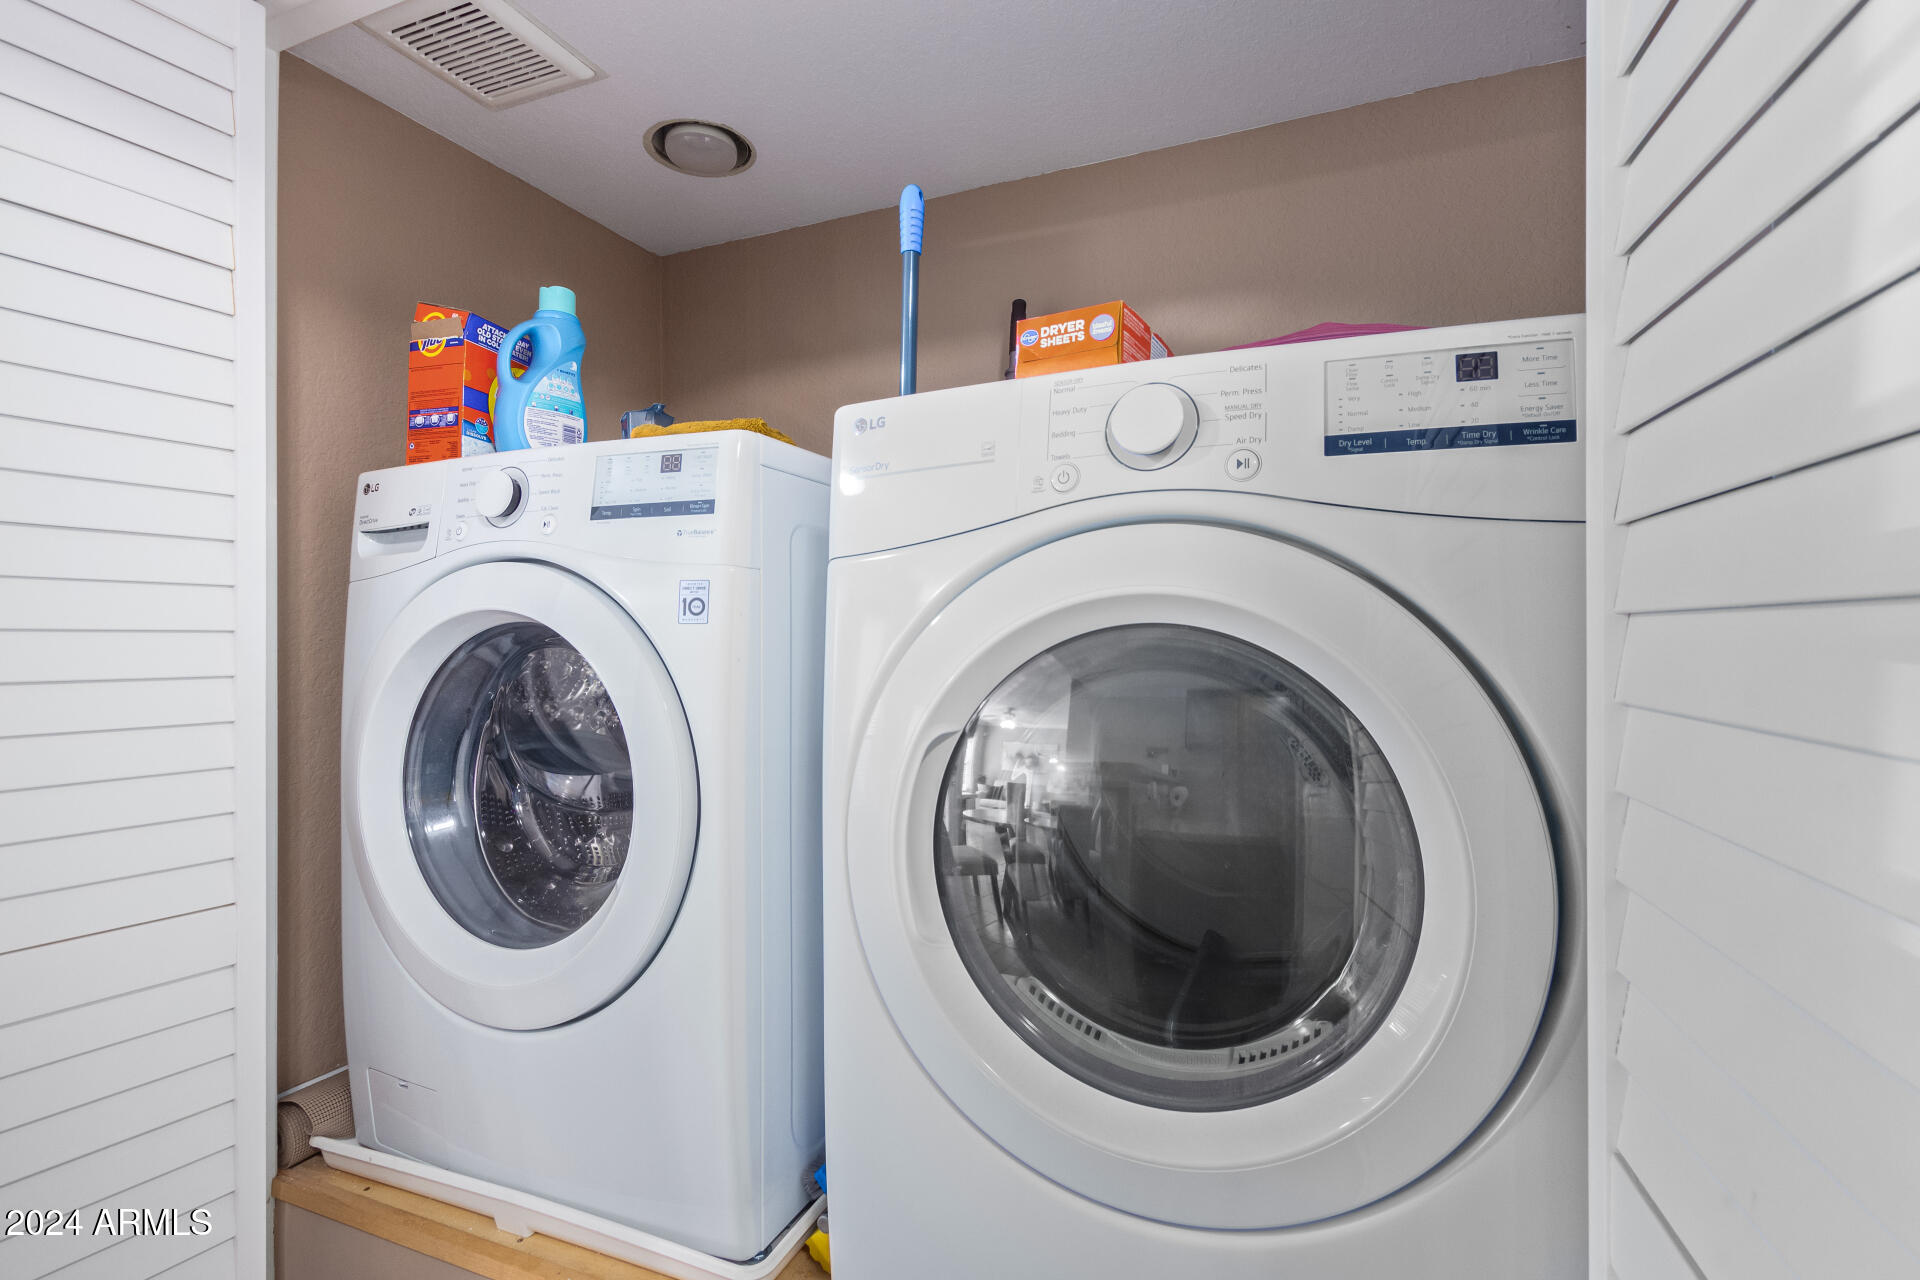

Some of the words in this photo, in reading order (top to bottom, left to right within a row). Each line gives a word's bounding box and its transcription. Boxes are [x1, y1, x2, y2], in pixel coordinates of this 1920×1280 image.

[477, 328, 491, 338] OLD
[482, 323, 506, 338] ATTAC
[1040, 319, 1085, 338] DRYER
[478, 335, 486, 343] IN
[486, 339, 501, 349] COL
[1040, 331, 1085, 348] SHEETS
[1229, 363, 1262, 373] Delicates
[1054, 385, 1076, 394] Normal
[1242, 387, 1262, 395] Press
[1052, 408, 1072, 417] Heavy
[1072, 405, 1088, 415] Duty
[1520, 405, 1543, 413] Energy
[1225, 412, 1247, 422] Speed
[1249, 411, 1262, 420] Dry
[869, 416, 886, 431] LG
[1462, 431, 1481, 439] Time
[1482, 430, 1497, 438] Dry
[1523, 427, 1549, 435] Wrinkle
[1236, 437, 1248, 445] Air
[1250, 436, 1262, 445] Dry
[1338, 440, 1352, 448] Dry
[1353, 438, 1373, 446] Level
[682, 597, 706, 616] 10
